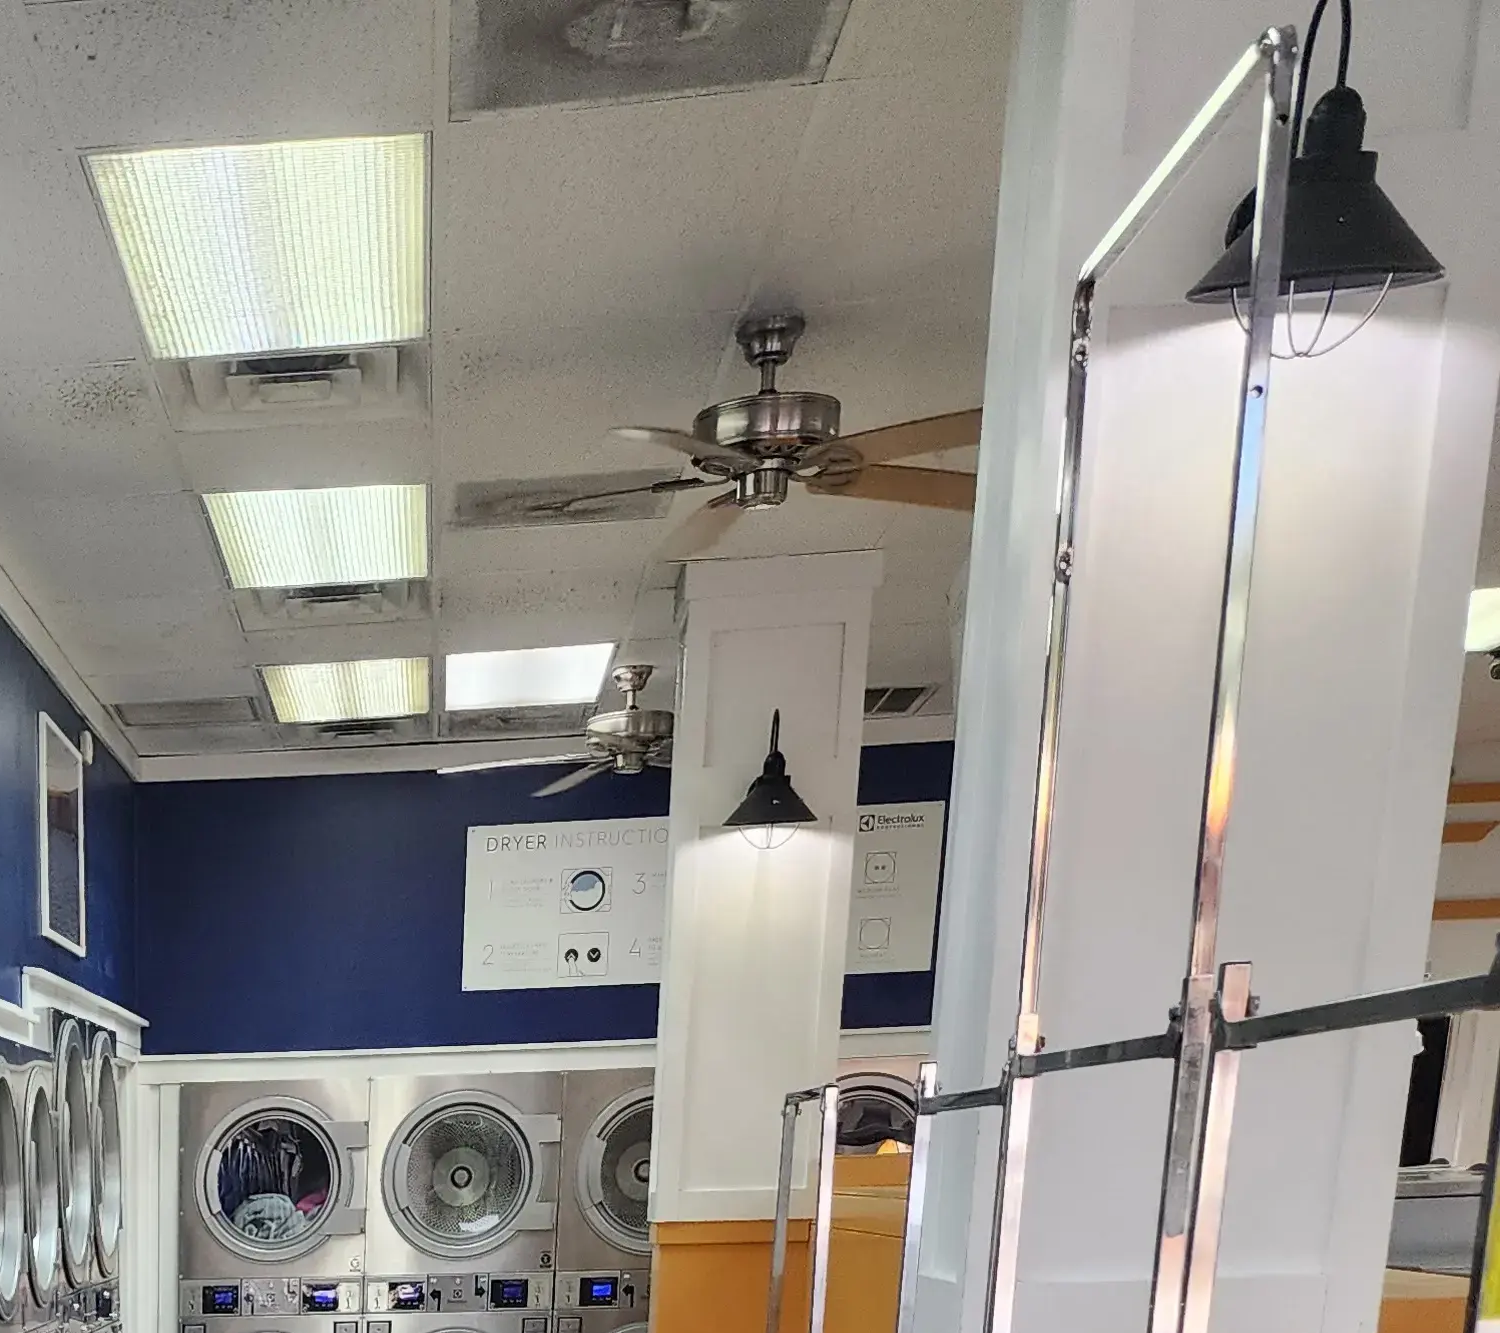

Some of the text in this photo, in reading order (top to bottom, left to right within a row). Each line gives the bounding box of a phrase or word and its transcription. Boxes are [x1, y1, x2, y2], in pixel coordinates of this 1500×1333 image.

[877, 813, 925, 825] Electrolux
[486, 827, 669, 852] DRYER INSTRUCTIO
[632, 873, 646, 895] 3
[482, 943, 494, 966] 2
[628, 937, 641, 958] 4
